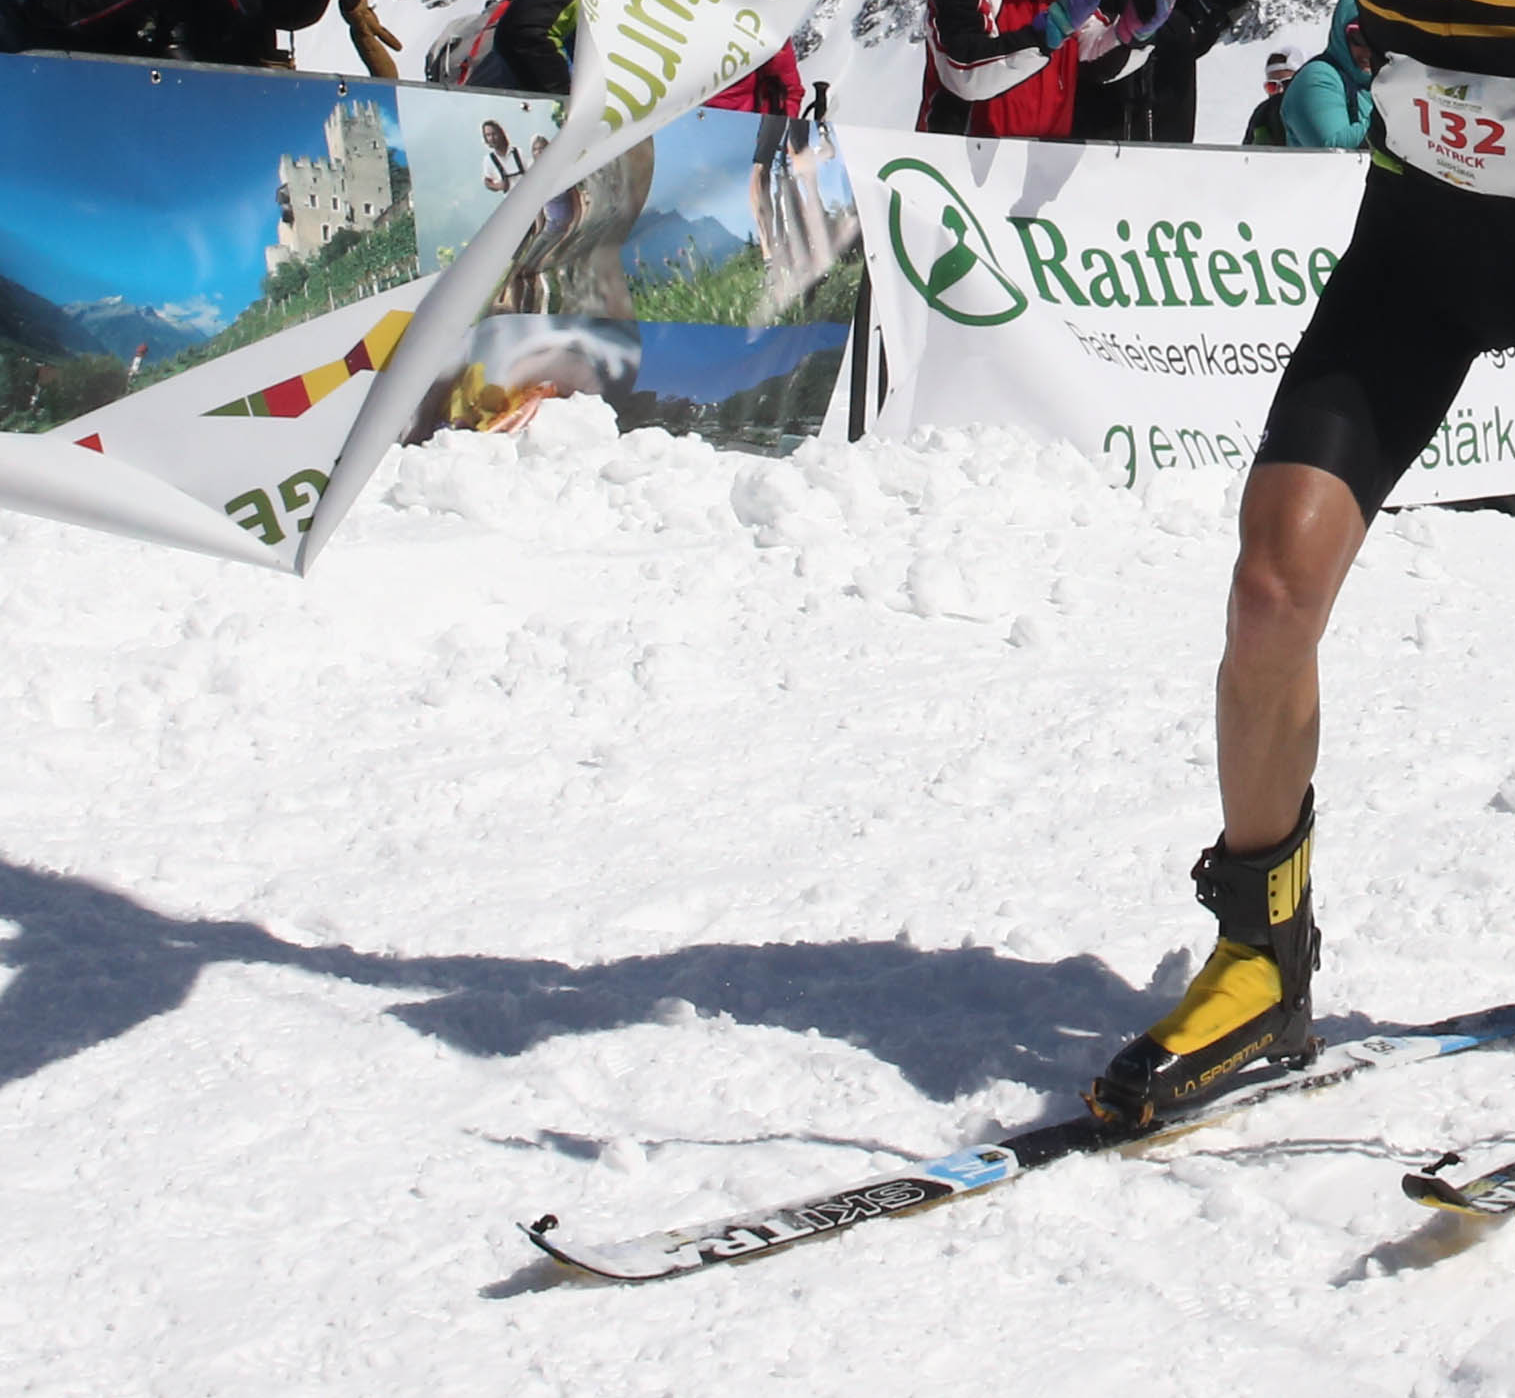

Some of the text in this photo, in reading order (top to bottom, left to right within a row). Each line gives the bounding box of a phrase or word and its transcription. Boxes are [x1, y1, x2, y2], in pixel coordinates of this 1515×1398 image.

[1413, 98, 1507, 157] 132
[1427, 139, 1486, 170] PATRICK
[1173, 1032, 1275, 1098] LA SPORTIVA
